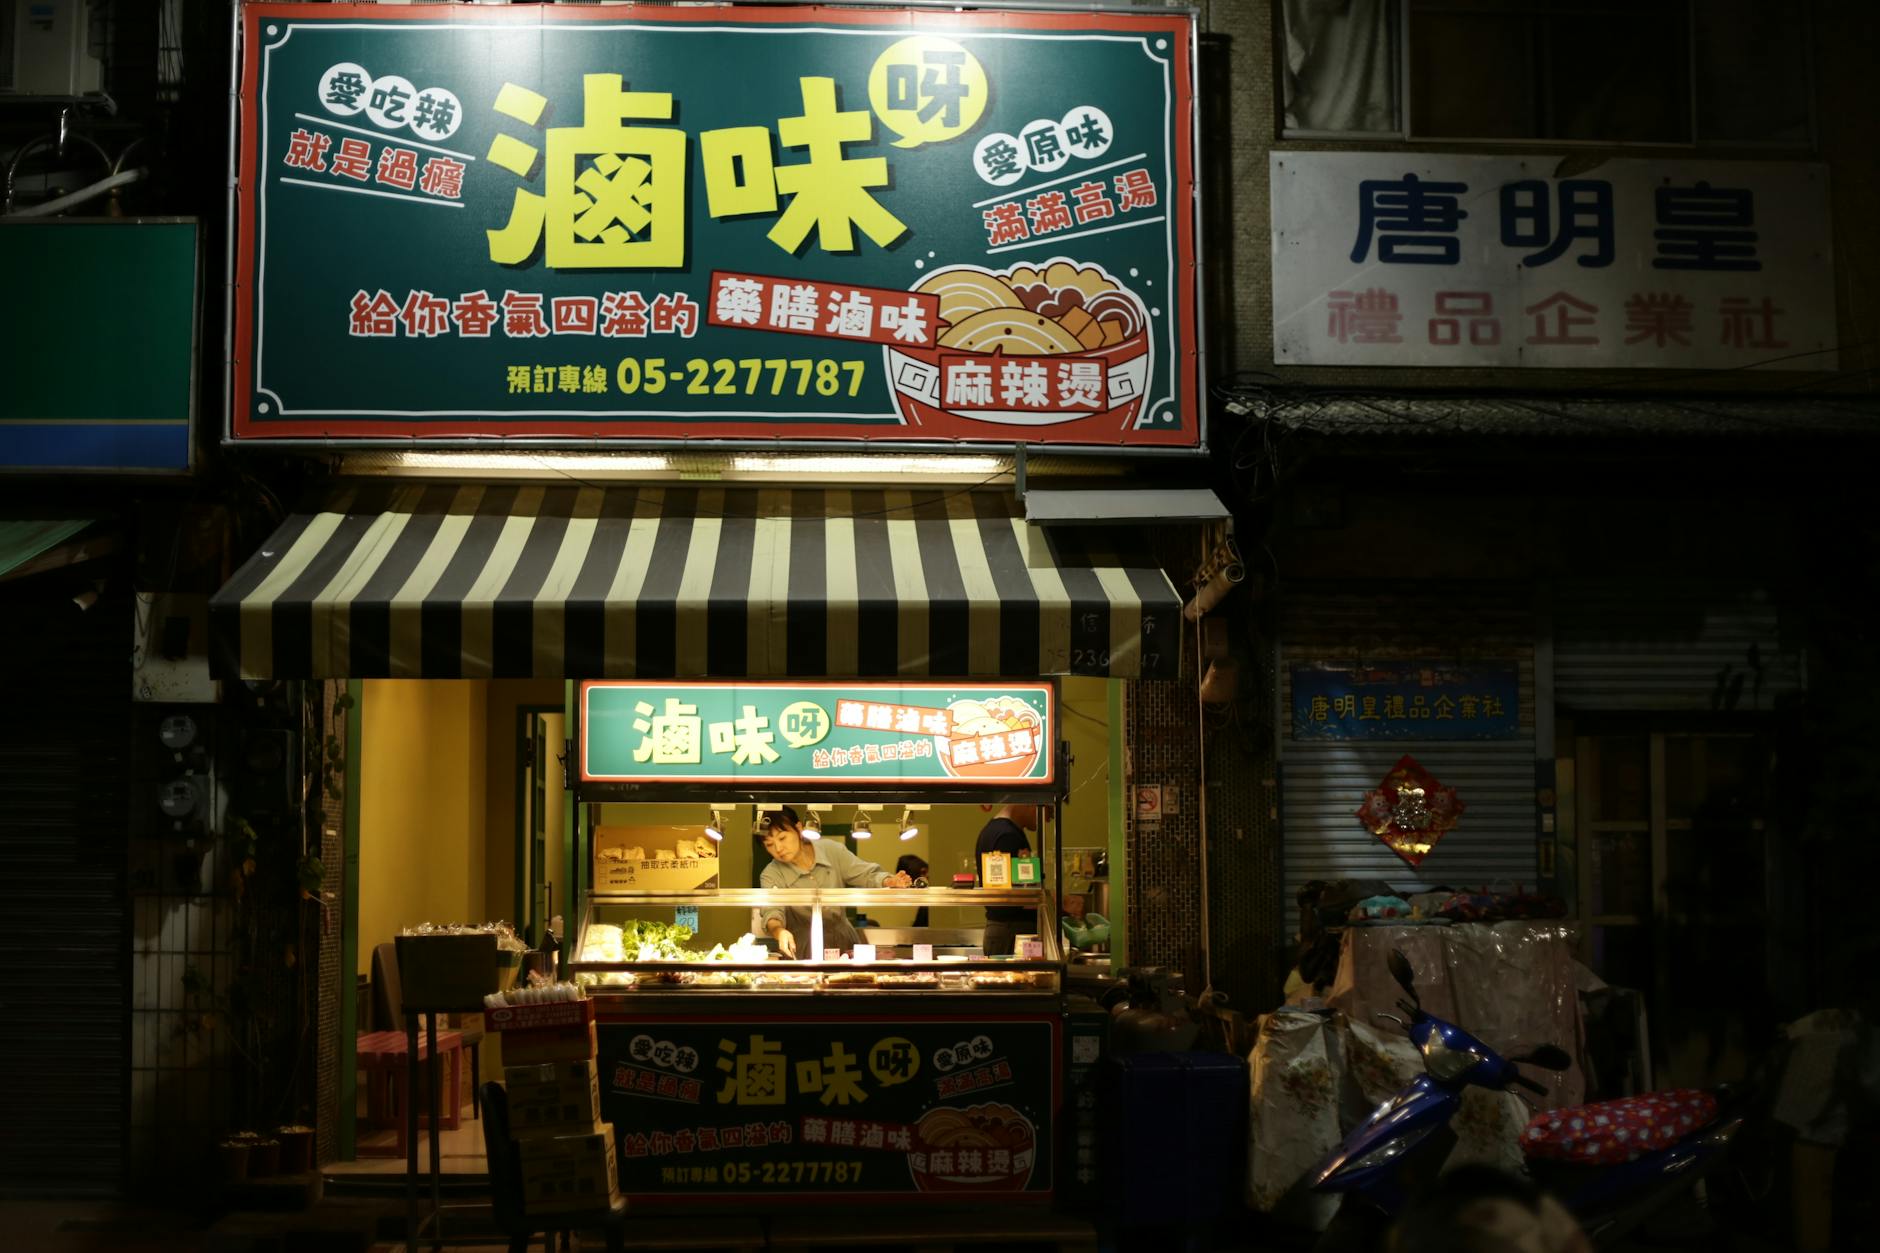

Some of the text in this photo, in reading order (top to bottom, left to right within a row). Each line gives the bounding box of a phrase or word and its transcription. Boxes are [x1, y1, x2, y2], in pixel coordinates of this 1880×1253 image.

[326, 71, 457, 136] 愛吃辣
[283, 128, 466, 199] 就是過癮
[981, 113, 1110, 181] 愛原味
[981, 168, 1158, 247] 滿滿高湯
[1350, 172, 1762, 272] 唐明皇
[348, 289, 699, 339] 給你香氣四溢的
[715, 278, 929, 344] 藥膳滷味
[1326, 287, 1789, 350] 禮品企業社
[507, 357, 865, 397] 預訂專線 05-2277787
[945, 359, 1103, 409] 麻辣燙
[1308, 693, 1505, 722] 唐明皇禮品企業社
[812, 738, 933, 769] 給你香氣四溢的
[634, 1038, 696, 1070] 愛吃辣
[937, 1038, 991, 1068] 愛原味
[624, 1120, 793, 1159] 給你香氣四溢的
[802, 1116, 913, 1151] 藥膳滷味
[722, 1160, 864, 1185] 05-2277787
[929, 1150, 1011, 1174] 麻辣燙
